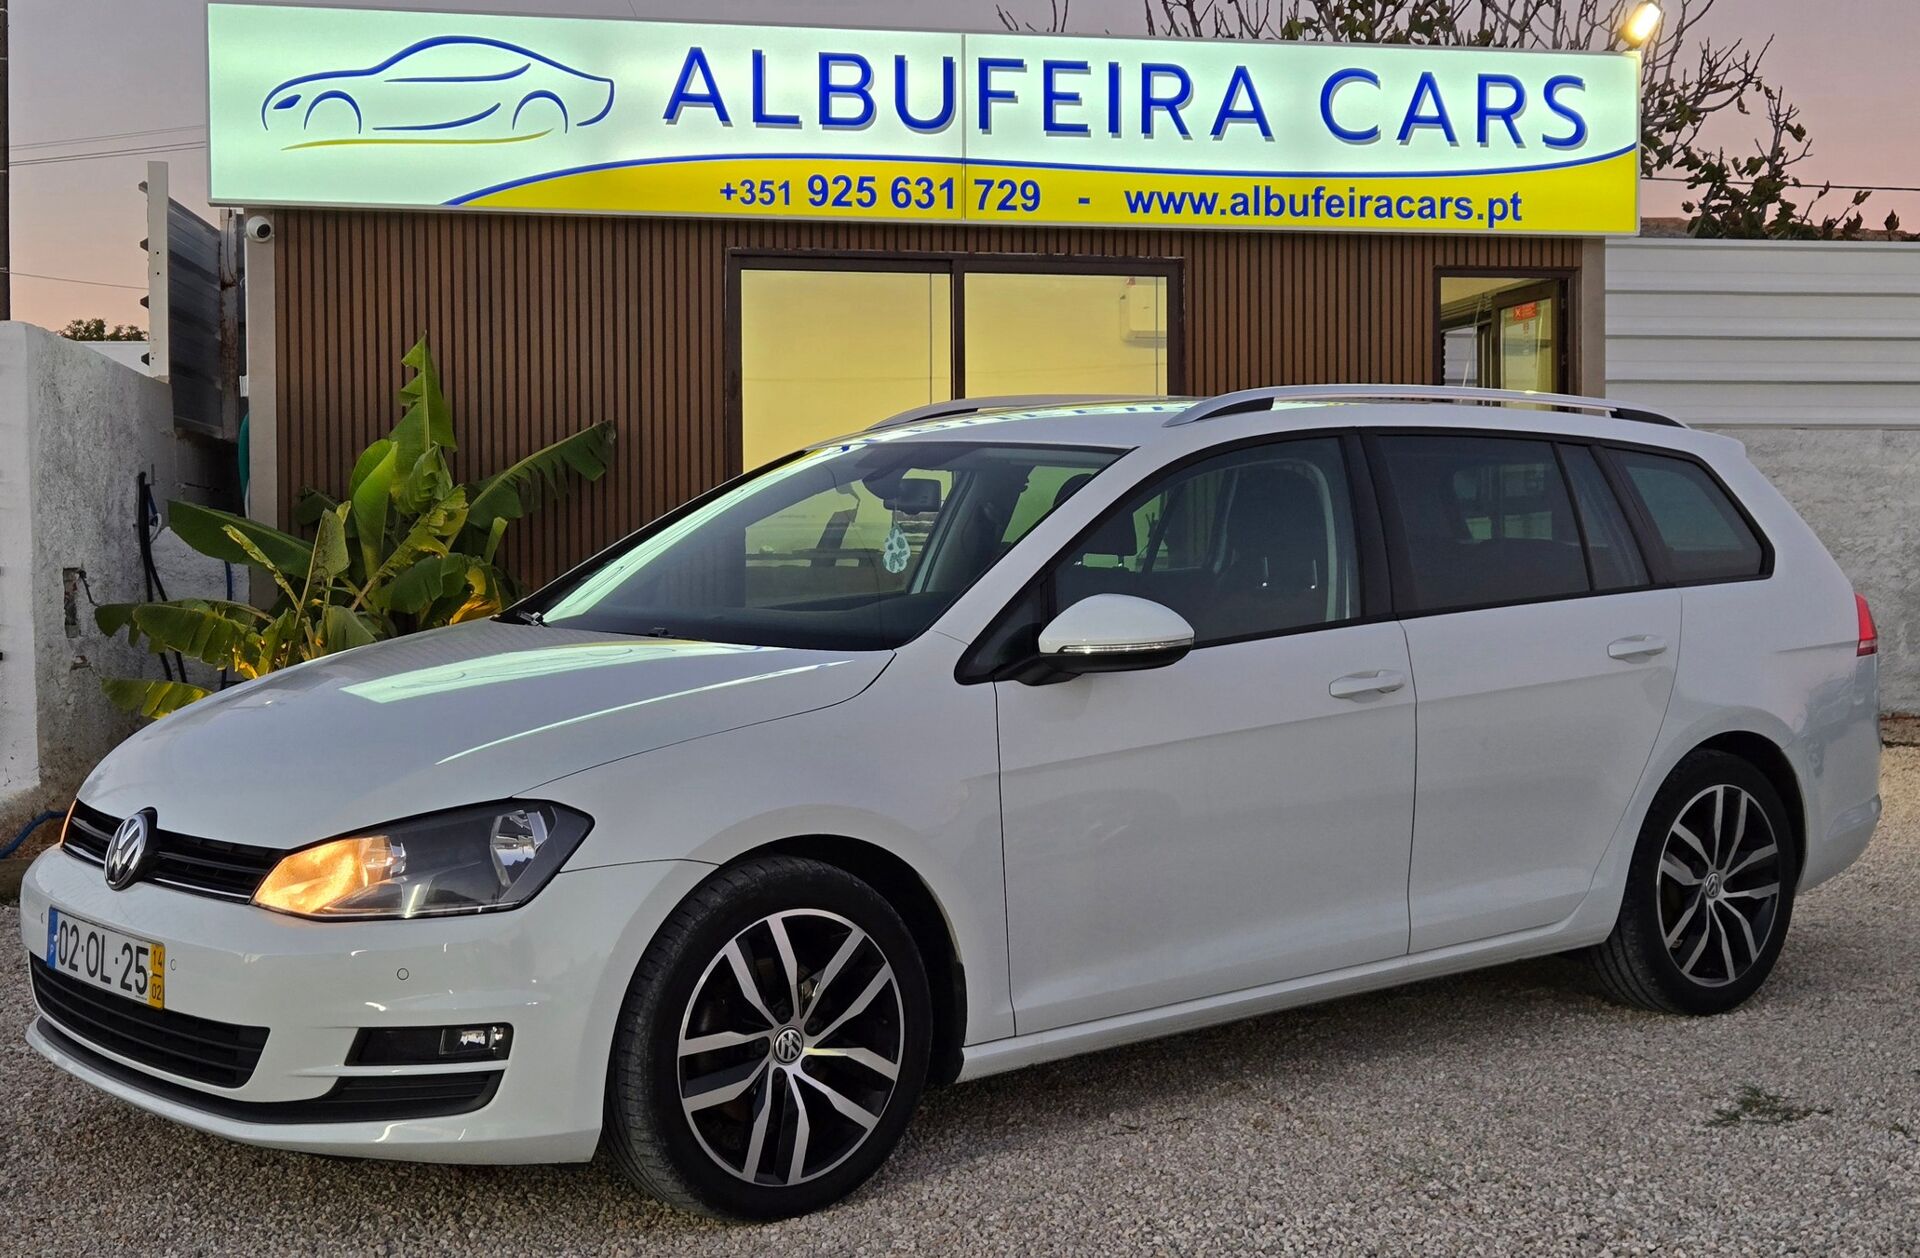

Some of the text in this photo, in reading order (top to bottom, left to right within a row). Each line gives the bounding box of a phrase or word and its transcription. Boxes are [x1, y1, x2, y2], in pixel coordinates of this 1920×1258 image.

[663, 46, 1587, 149] ALBUFEIRA CARS
[719, 180, 791, 206] +351
[807, 174, 877, 209] 925
[890, 176, 954, 210] 631
[973, 178, 1041, 212] 729
[1124, 185, 1523, 228] www.albufeiracars.pt
[151, 983, 162, 1001] 02
